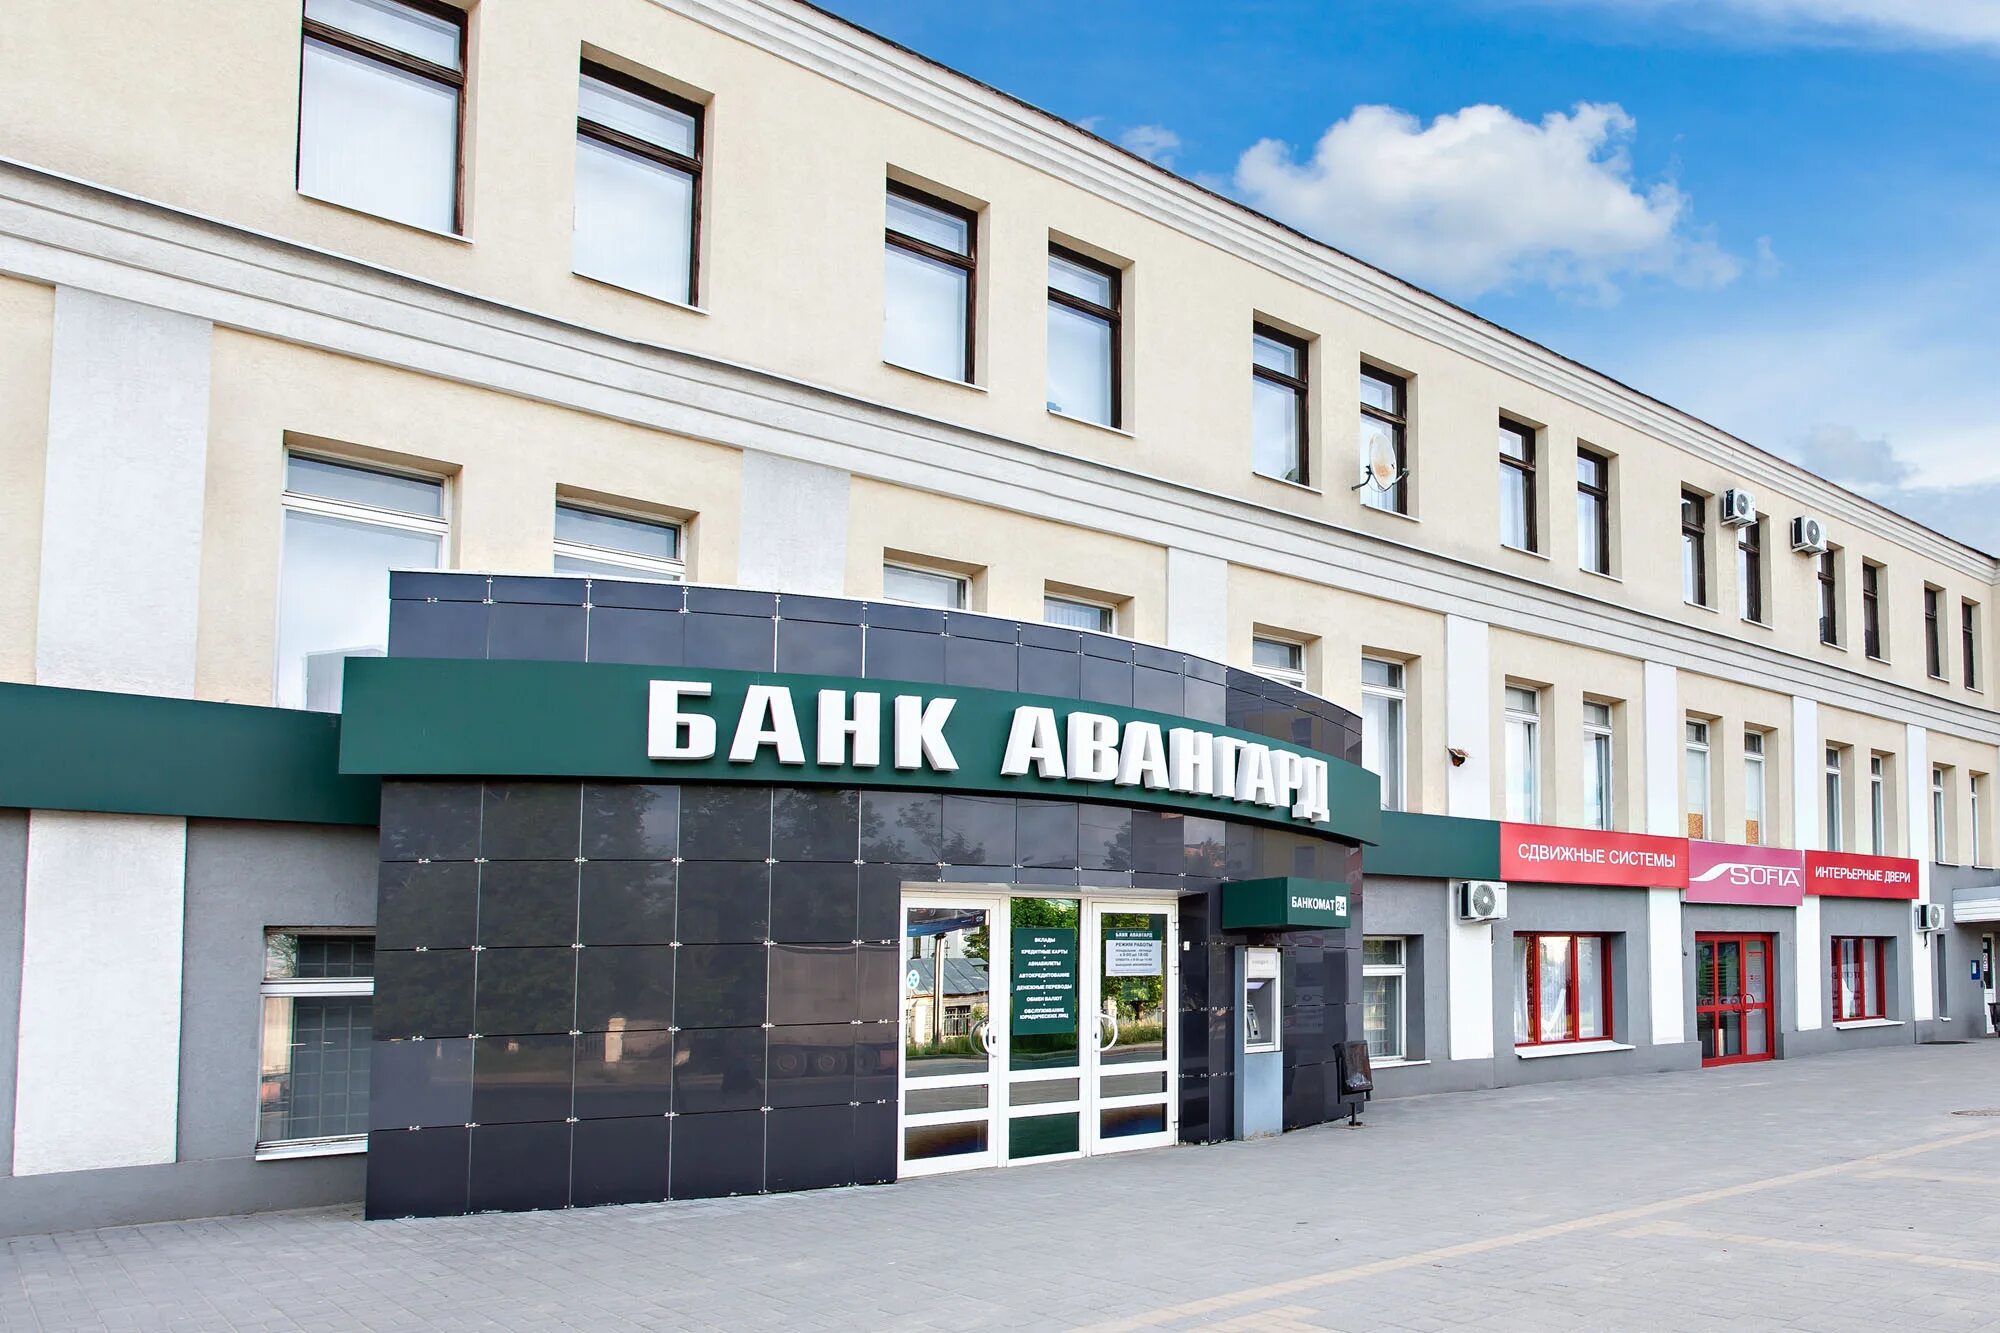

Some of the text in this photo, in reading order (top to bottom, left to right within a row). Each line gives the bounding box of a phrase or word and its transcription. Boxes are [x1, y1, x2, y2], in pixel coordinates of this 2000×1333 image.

[647, 679, 1331, 823] БАНК АВАНГАРД
[1518, 843, 1677, 868] СДВИЖНЫЕ СИСТЕМЫ
[1729, 864, 1801, 888] SOFIA
[1815, 866, 1911, 884] ИНТЕРЬЕРНЫЕ ДВЕРИ
[1291, 896, 1346, 911] БАНКОМАТ 24
